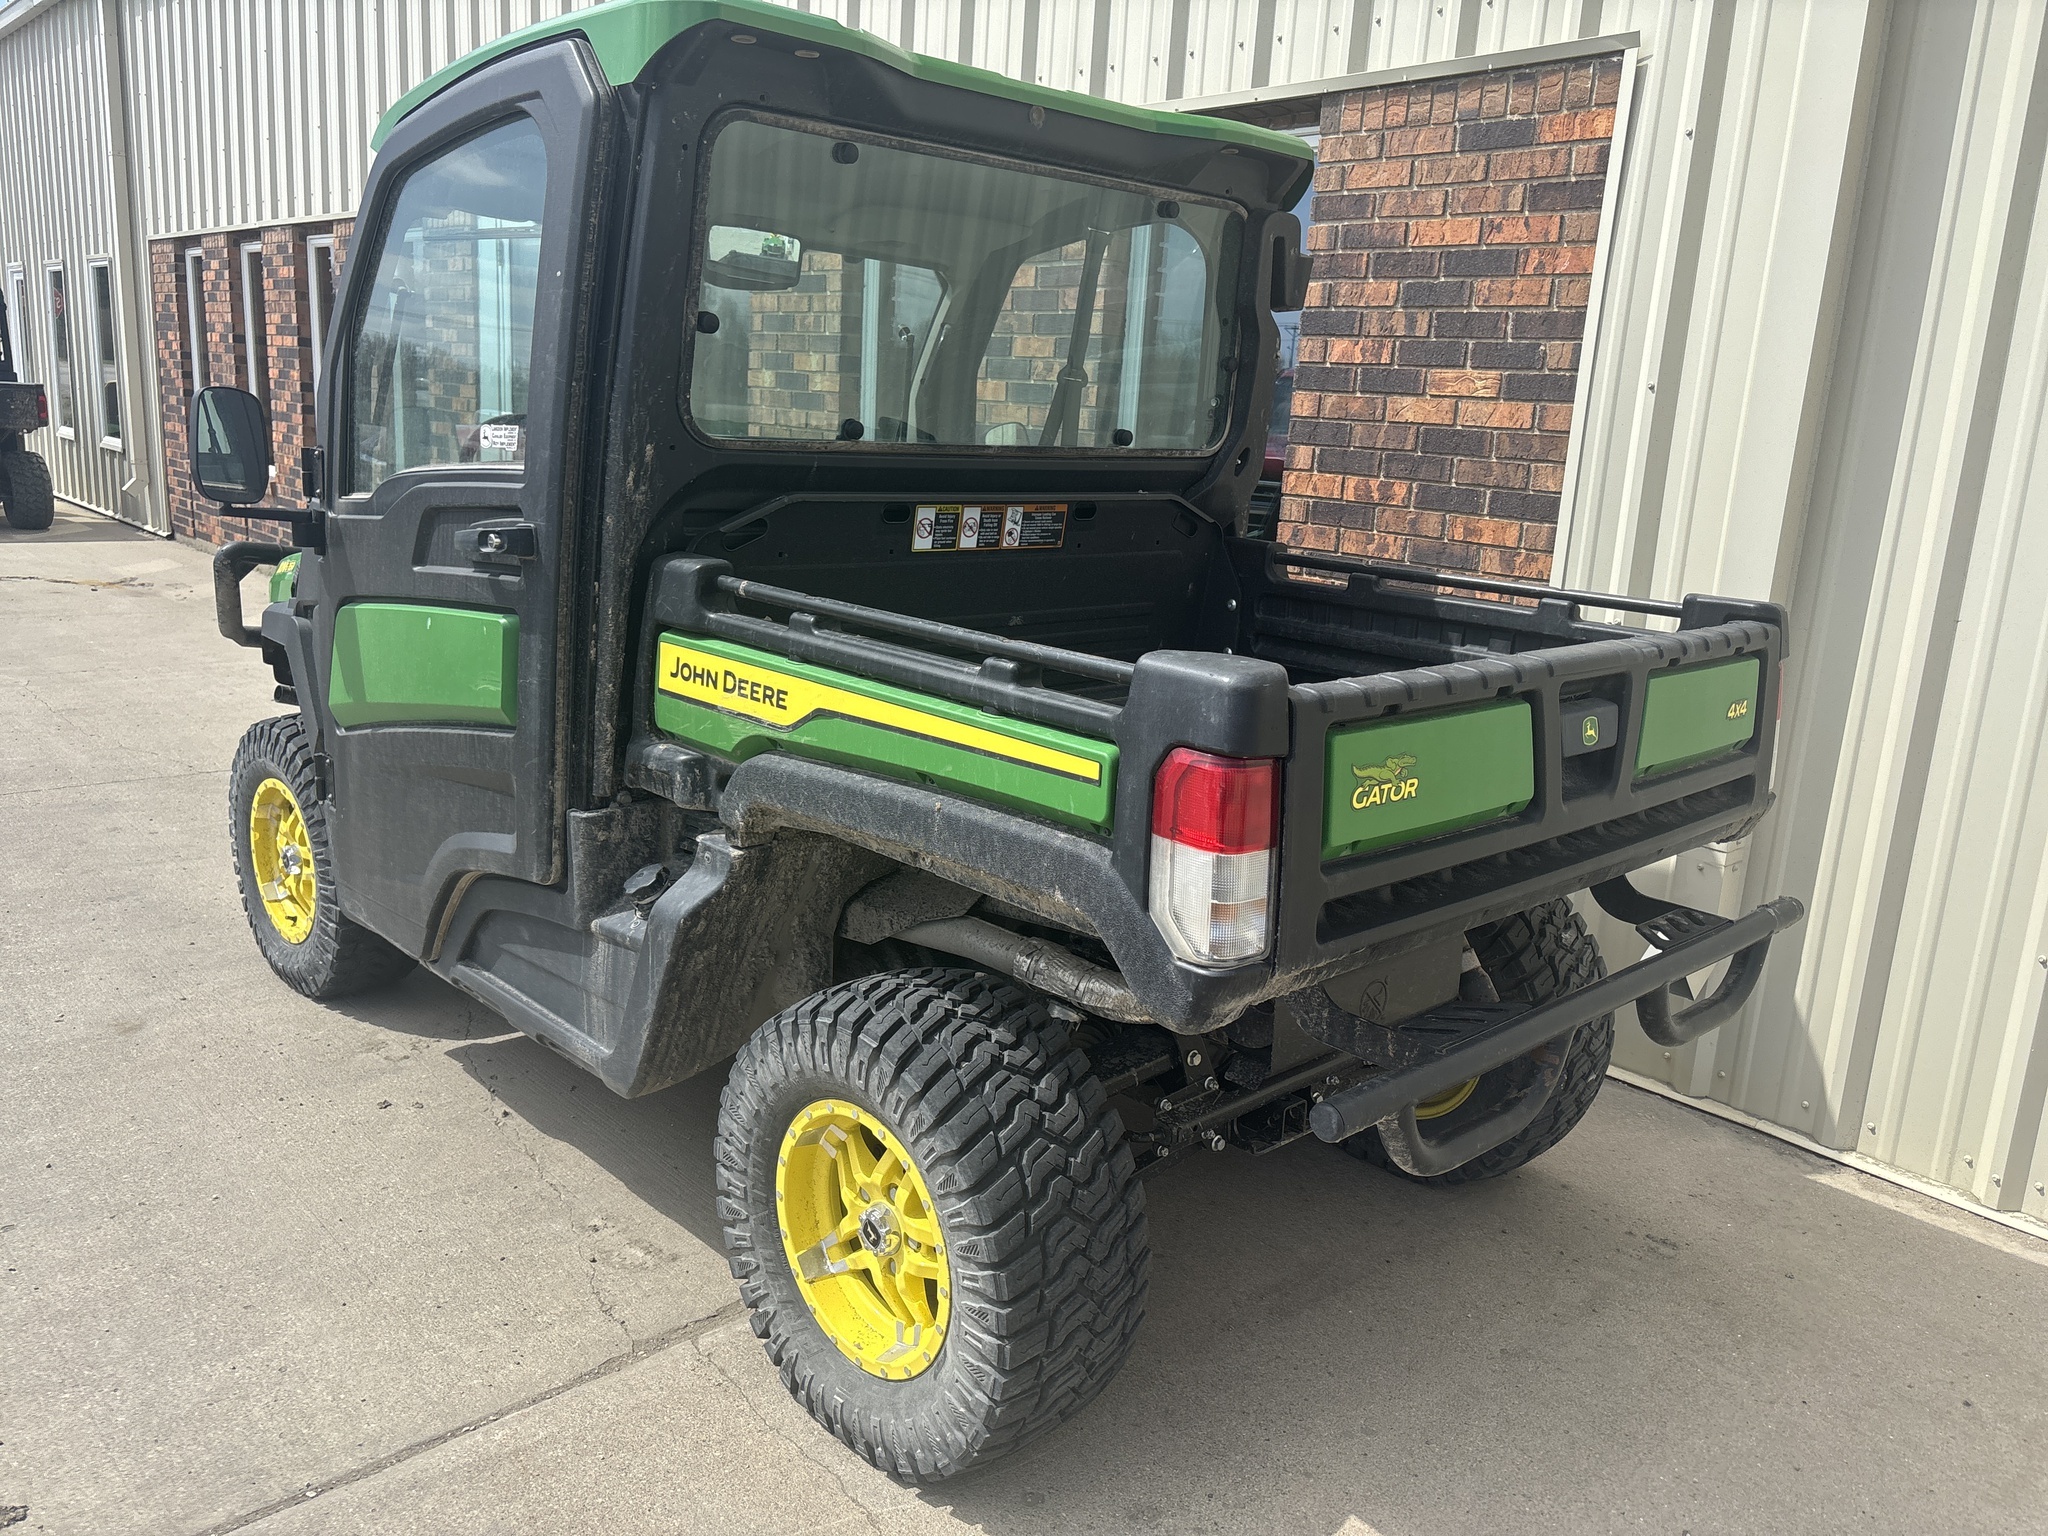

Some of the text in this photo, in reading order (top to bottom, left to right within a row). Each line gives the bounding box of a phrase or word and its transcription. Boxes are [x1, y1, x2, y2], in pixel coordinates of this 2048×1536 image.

[670, 656, 788, 711] JOHN DEERE
[1352, 777, 1419, 810] GATOR
